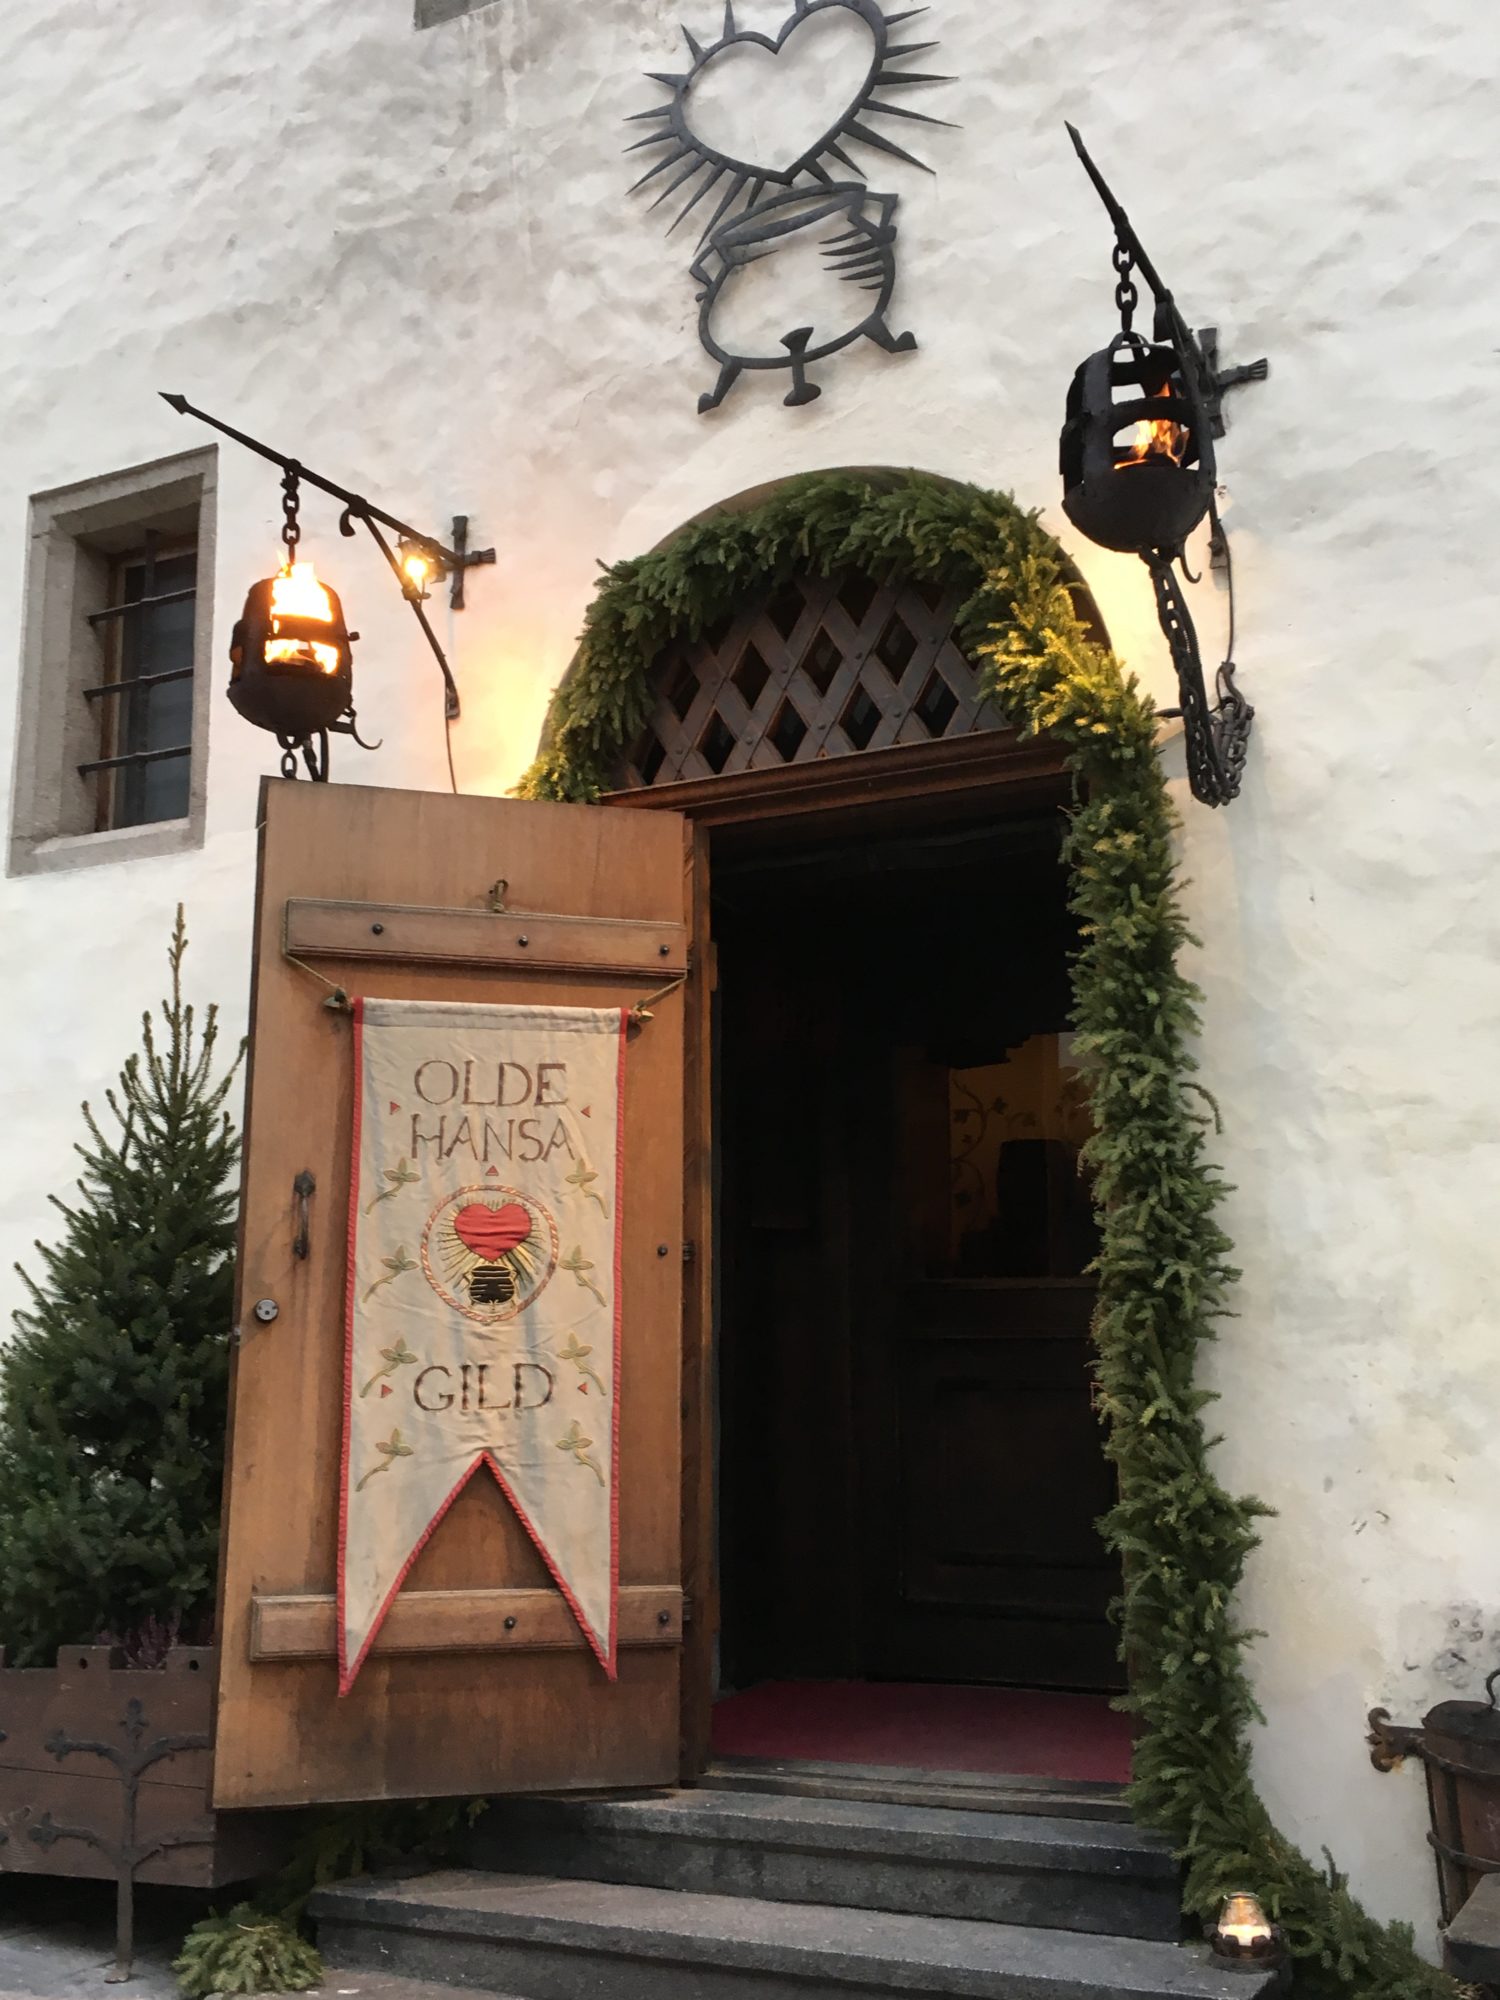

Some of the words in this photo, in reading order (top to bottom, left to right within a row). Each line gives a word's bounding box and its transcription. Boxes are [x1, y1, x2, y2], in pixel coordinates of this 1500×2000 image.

[414, 1060, 568, 1107] OLDE
[411, 1113, 575, 1162] HANSA
[414, 1363, 554, 1411] GILD
